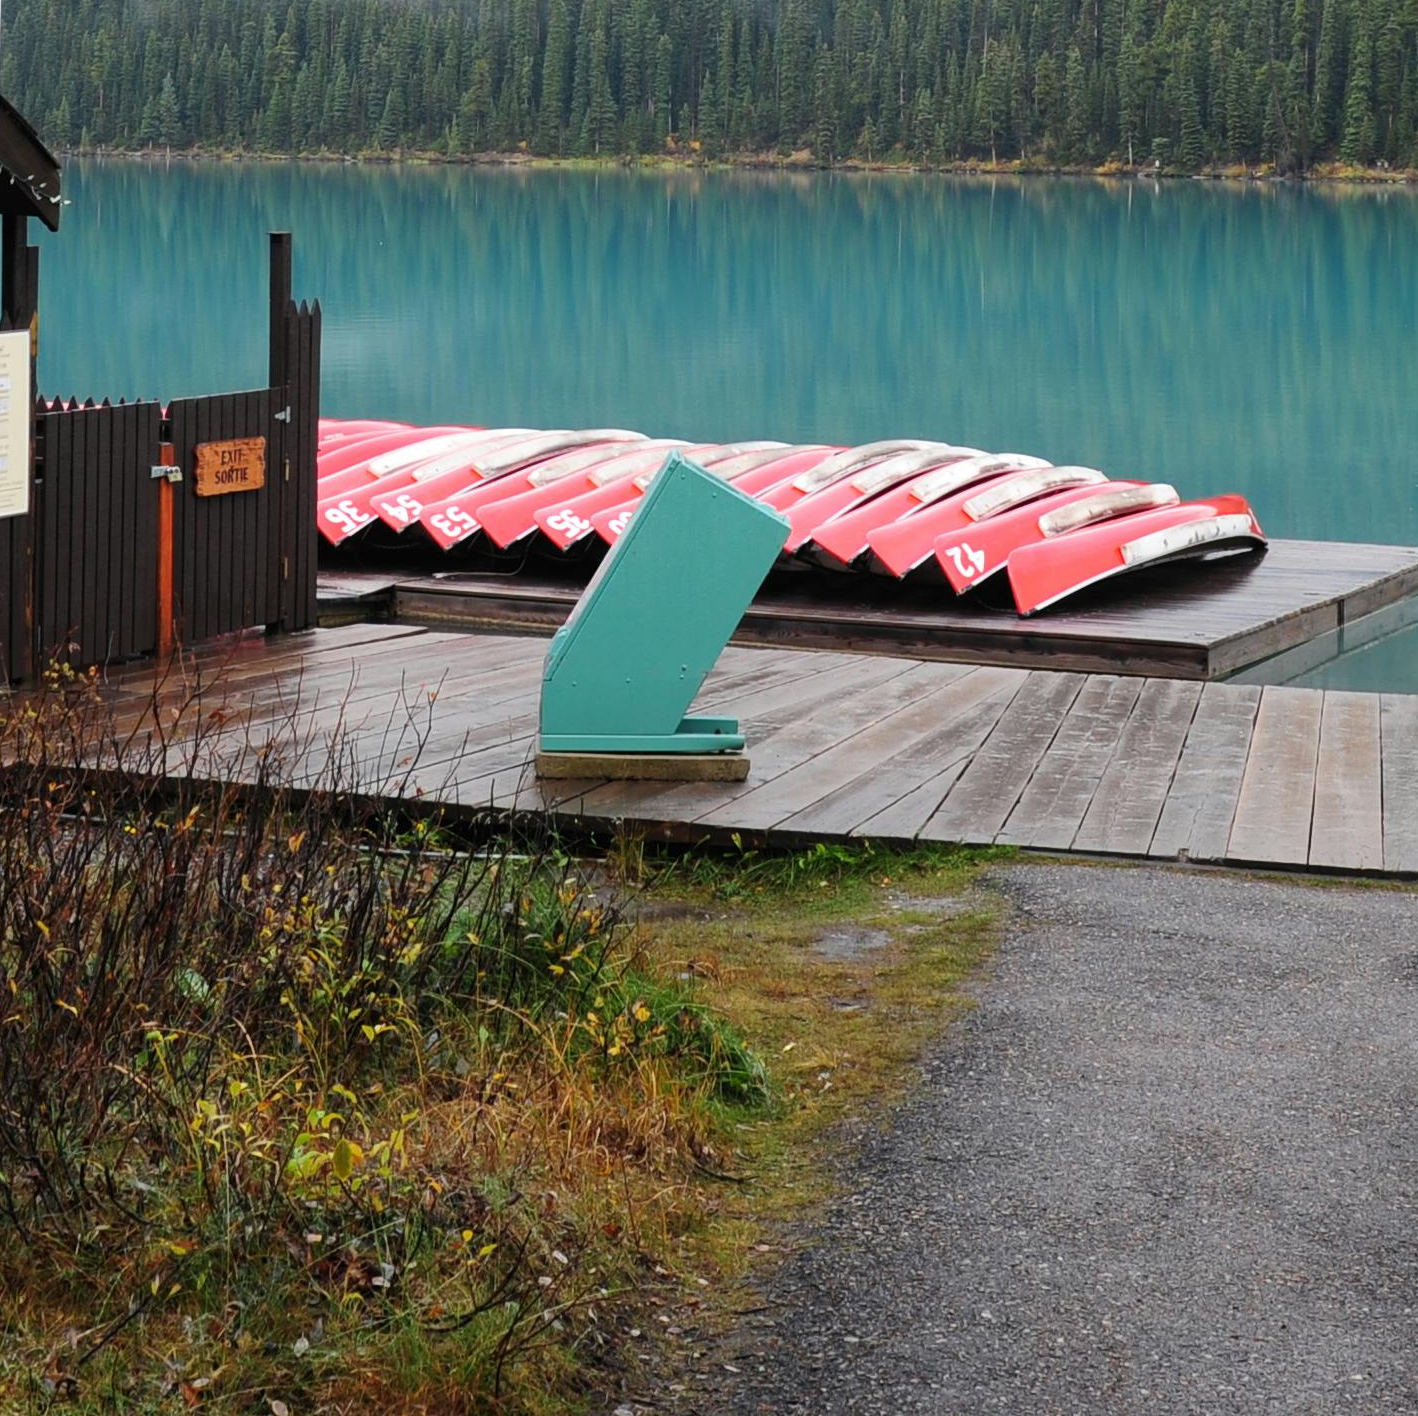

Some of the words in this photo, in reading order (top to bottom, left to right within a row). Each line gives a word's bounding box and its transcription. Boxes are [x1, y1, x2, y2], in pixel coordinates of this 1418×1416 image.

[221, 448, 243, 465] EXIT
[215, 467, 248, 484] SORTIE
[380, 494, 424, 523] 54
[430, 506, 477, 537] 53
[546, 509, 590, 538] 35
[945, 542, 985, 578] 42
